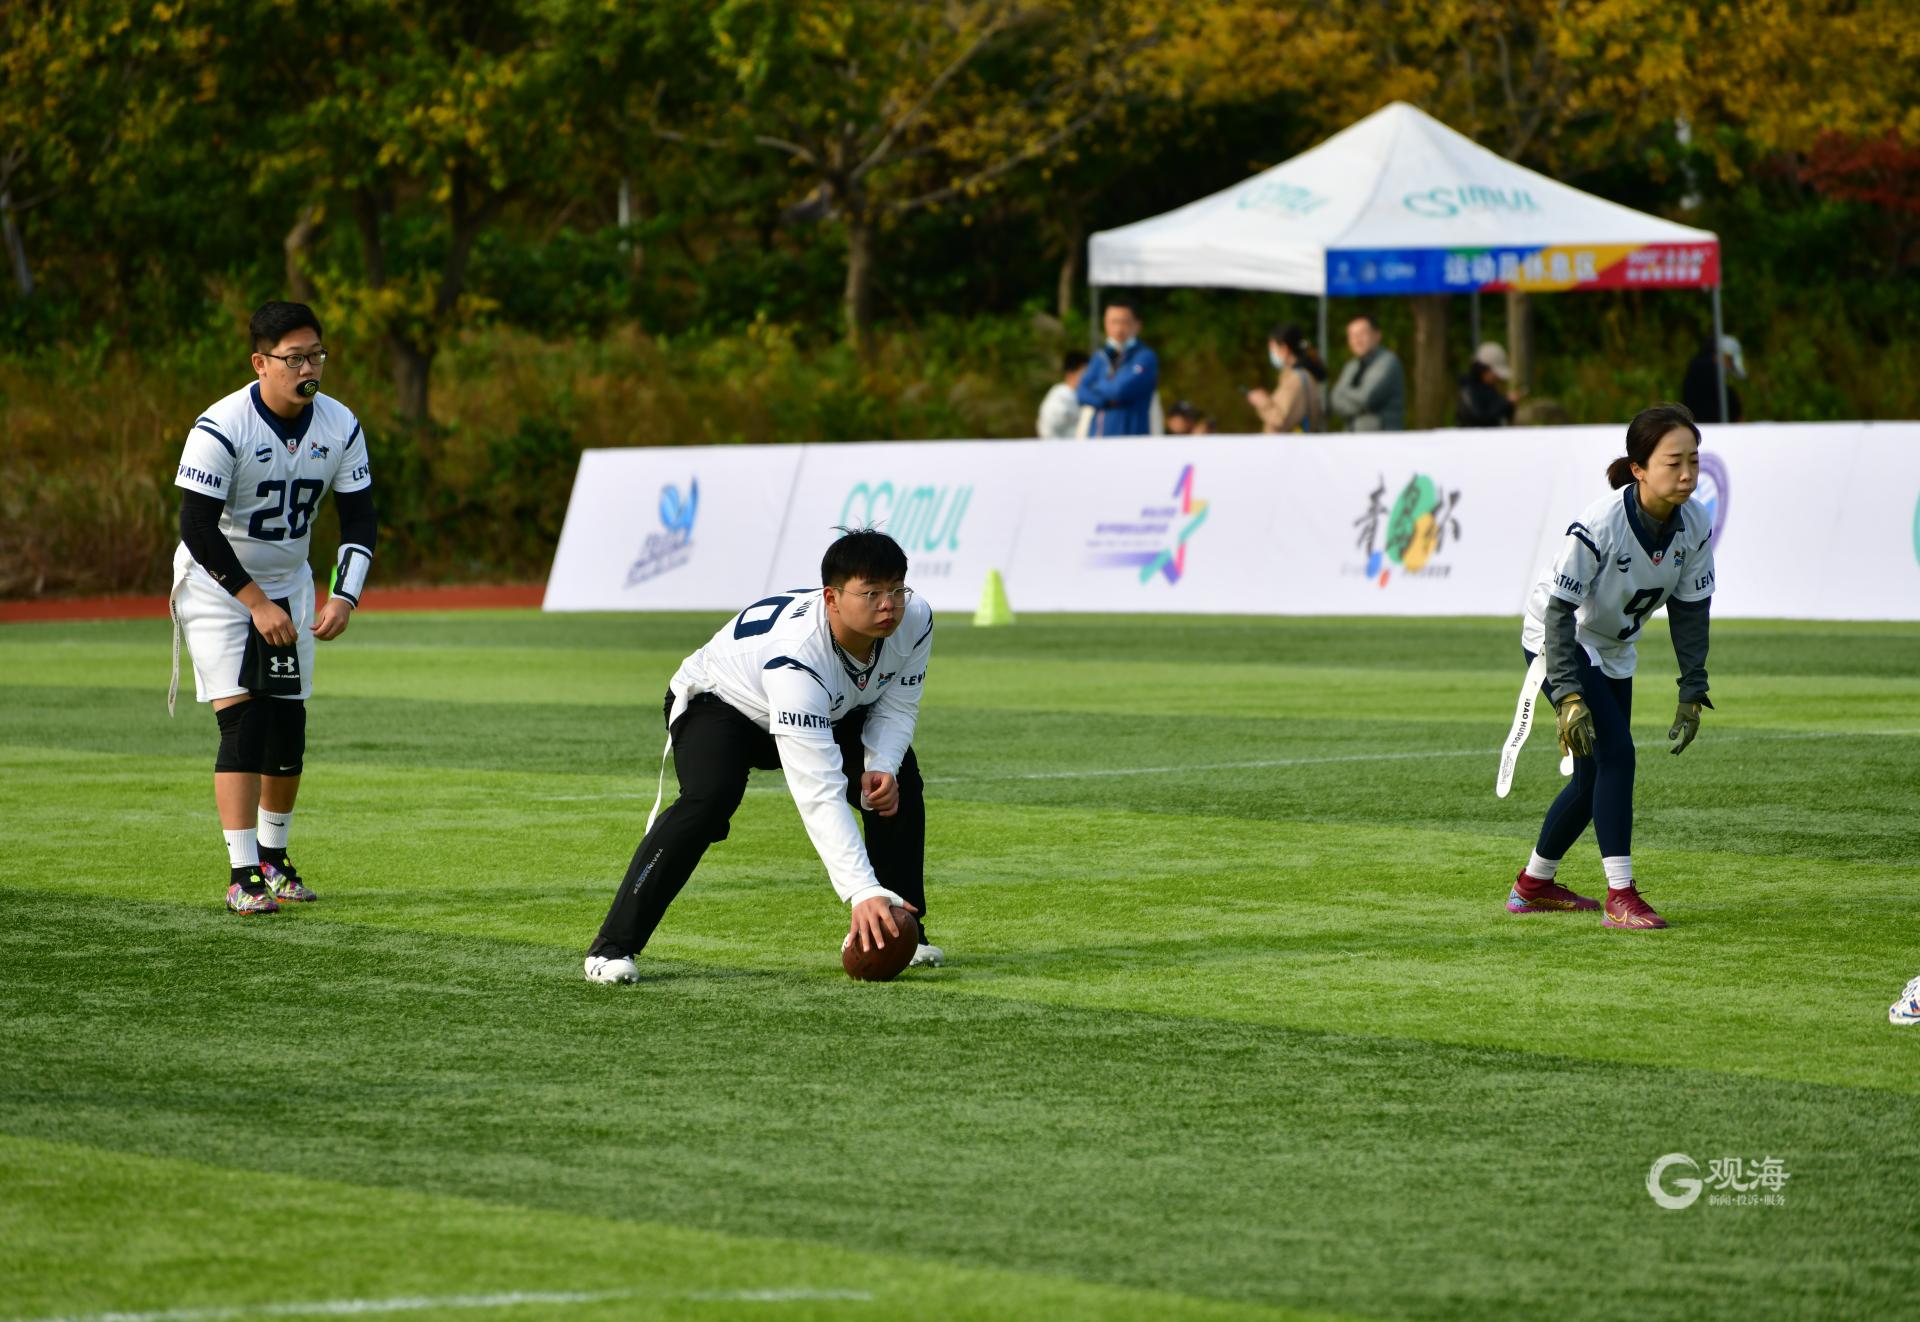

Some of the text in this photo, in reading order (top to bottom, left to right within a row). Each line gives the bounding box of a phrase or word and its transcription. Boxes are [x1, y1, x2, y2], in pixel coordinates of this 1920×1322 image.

[248, 478, 325, 542] 28
[1617, 587, 1665, 641] 9
[1511, 721, 1528, 748] HUDDLE
